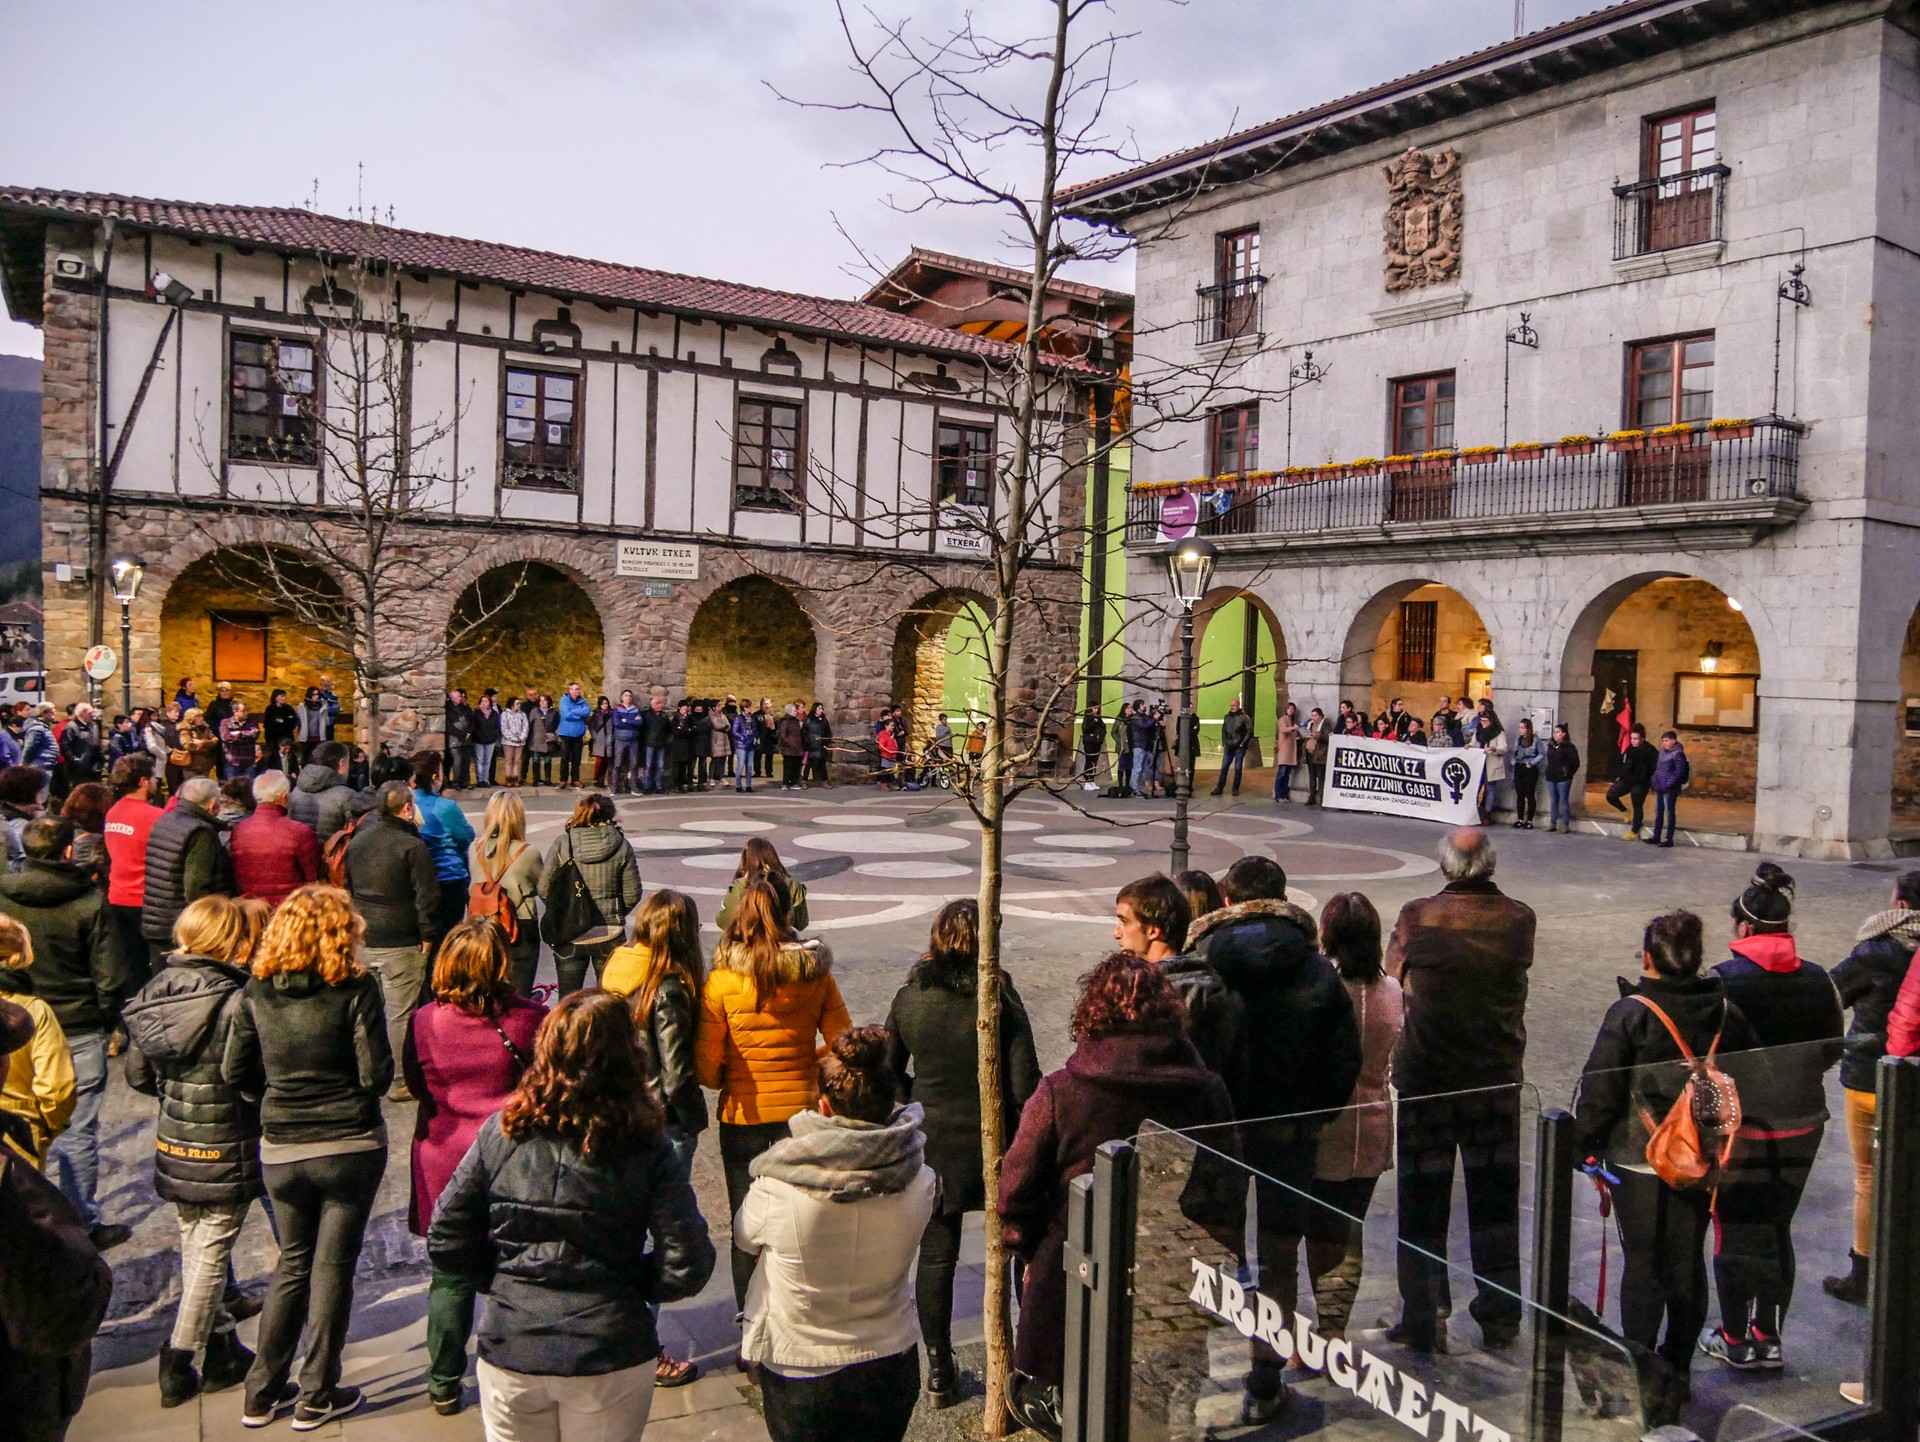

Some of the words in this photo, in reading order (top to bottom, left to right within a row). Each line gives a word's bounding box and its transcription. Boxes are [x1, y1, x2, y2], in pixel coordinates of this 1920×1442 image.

[947, 538, 980, 548] ETXERA
[663, 549, 691, 558] ETXEA
[1341, 750, 1401, 774] ERASORIK
[1404, 759, 1419, 776] EZ
[1339, 773, 1403, 794] ERANTZUNIK
[1405, 782, 1435, 799] GABE!
[170, 1145, 186, 1156] DEL
[188, 1148, 220, 1159] PRADO
